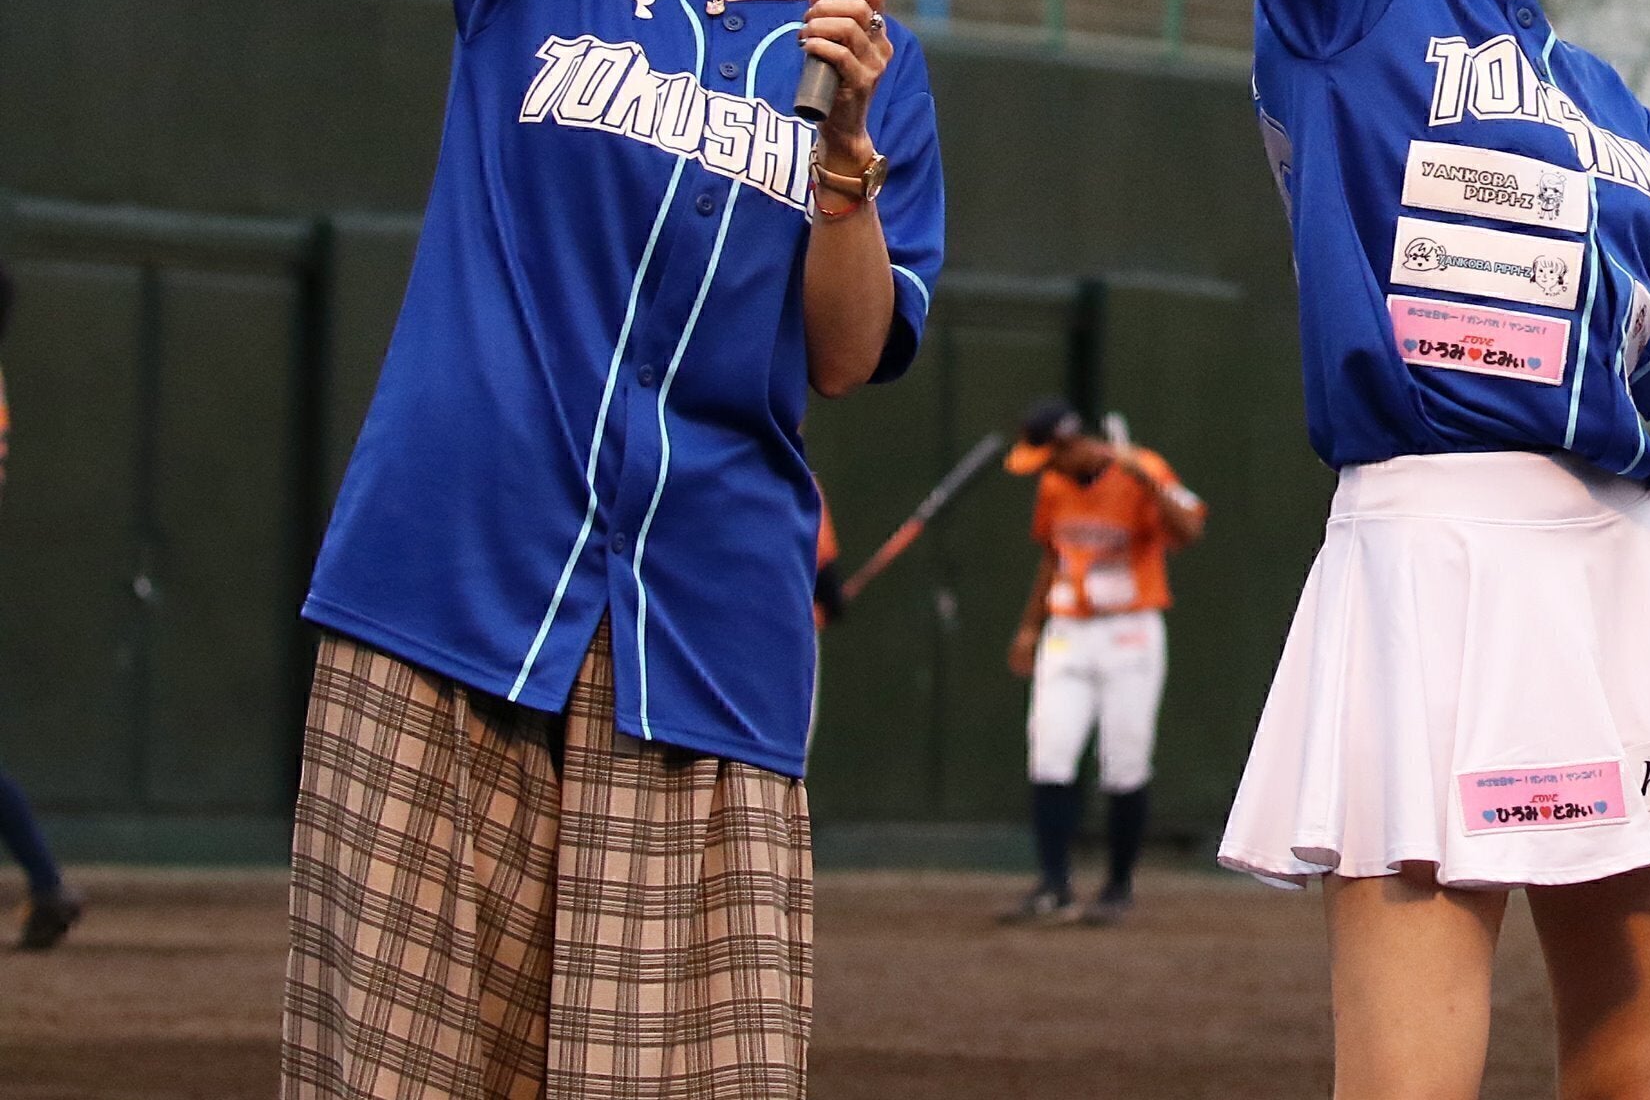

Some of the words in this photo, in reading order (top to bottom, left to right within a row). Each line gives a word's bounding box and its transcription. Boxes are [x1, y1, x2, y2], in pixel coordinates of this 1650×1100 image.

[519, 34, 816, 224] TOKUSHI
[1422, 161, 1518, 190] YANKOBA
[1464, 185, 1535, 209] PIPPI-Z
[1438, 255, 1492, 272] YANKOBA
[1494, 262, 1532, 278] PIPPI-Z
